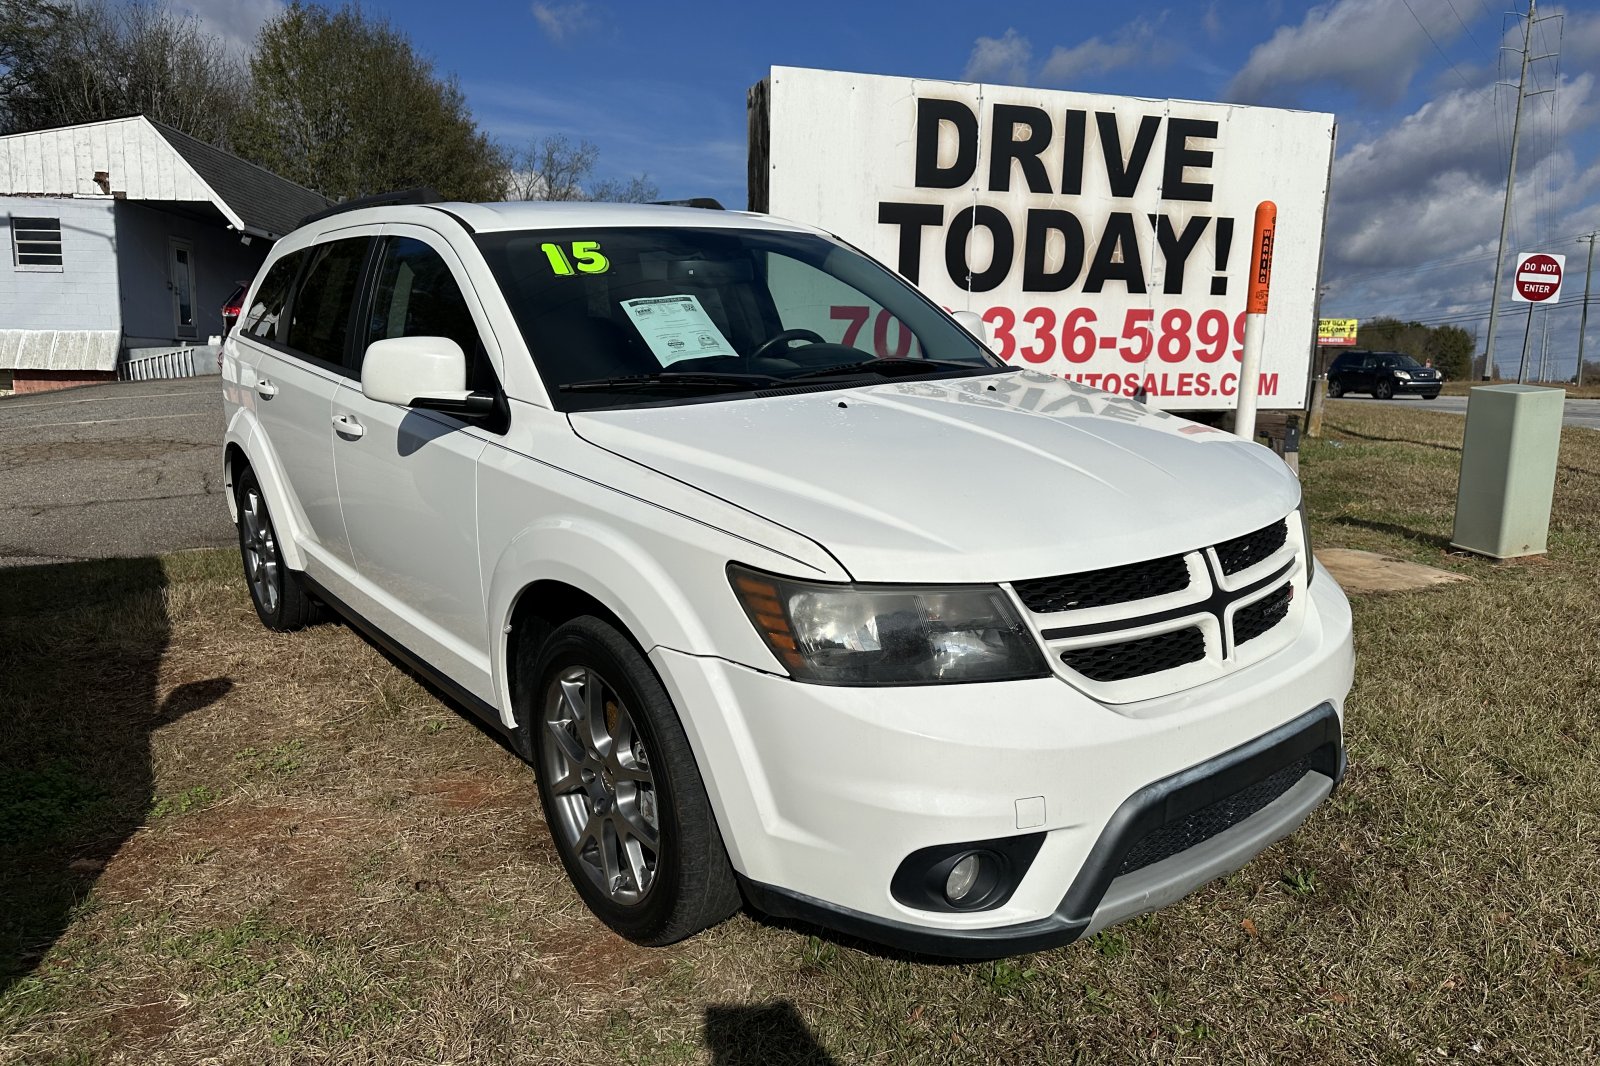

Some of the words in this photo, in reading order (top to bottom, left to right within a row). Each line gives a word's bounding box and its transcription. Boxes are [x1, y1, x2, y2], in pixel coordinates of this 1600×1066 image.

[915, 97, 1219, 202] DRIVE
[541, 241, 609, 275] 15
[878, 202, 1235, 296] TODAY!
[1259, 230, 1271, 283] WARNING
[1524, 262, 1536, 271] DO
[1540, 263, 1557, 273] NOT
[1523, 284, 1550, 293] ENTER
